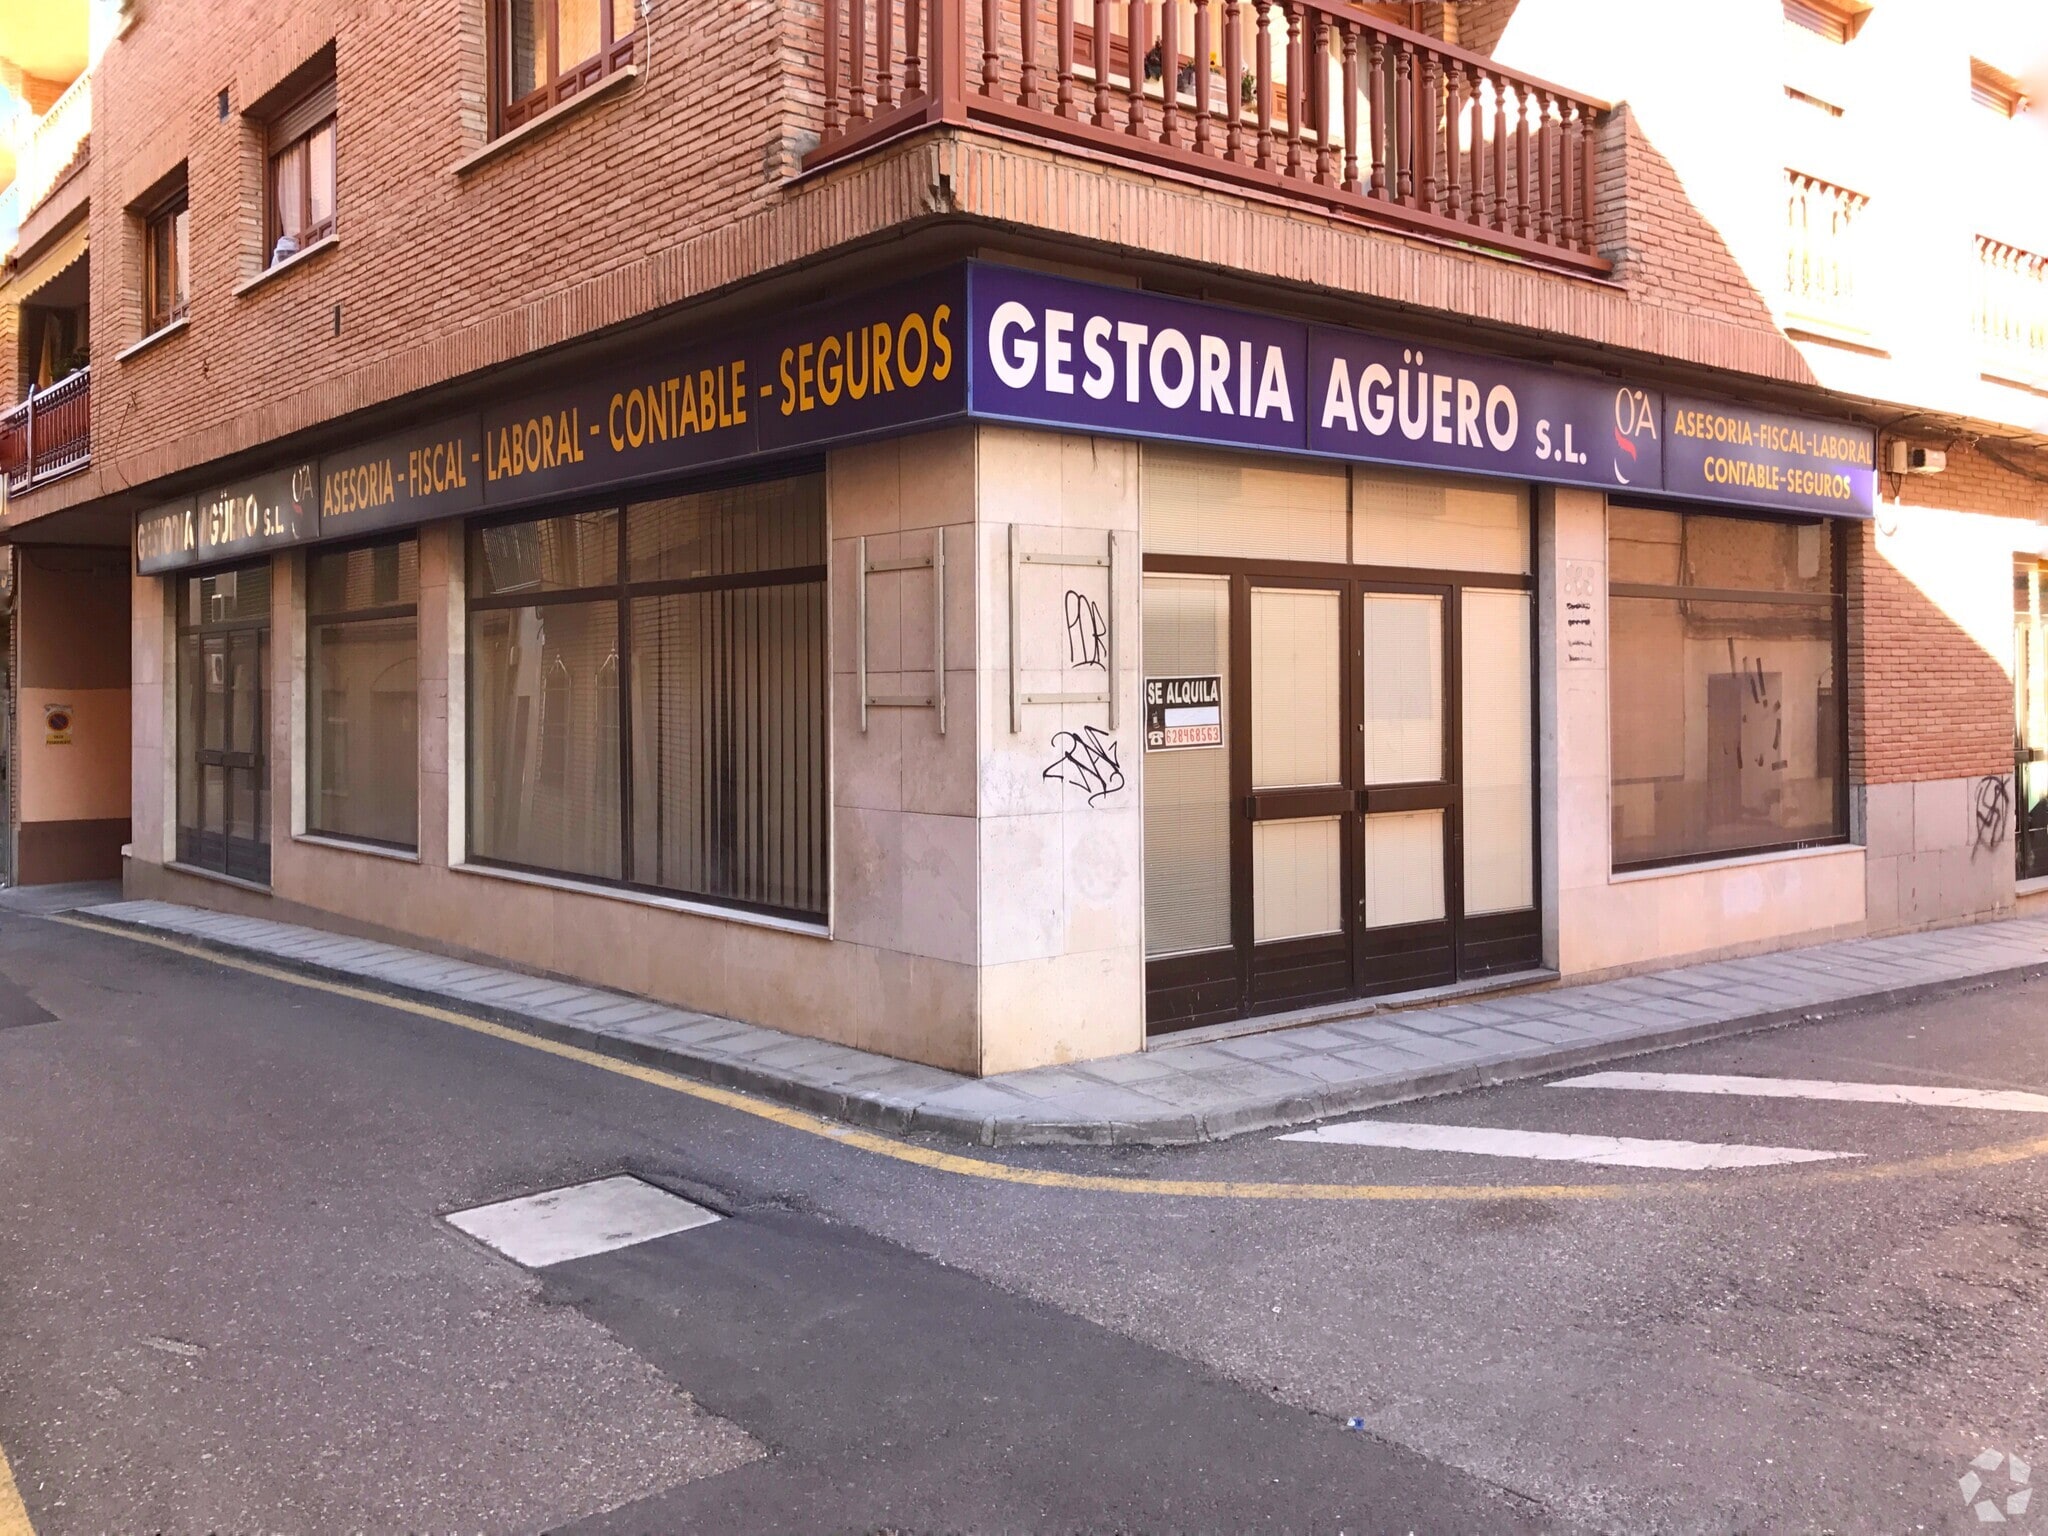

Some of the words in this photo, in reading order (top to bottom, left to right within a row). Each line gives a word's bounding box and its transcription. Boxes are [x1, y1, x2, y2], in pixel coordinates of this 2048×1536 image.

[323, 458, 395, 518] ASESORIA
[409, 438, 467, 498] FISCAL
[487, 406, 585, 482] LABORAL
[608, 359, 747, 453] CONTABLE
[779, 304, 953, 417] SEGUROS
[988, 301, 1295, 422] GESTORIA
[1321, 349, 1519, 452] AGÜERO
[1535, 419, 1588, 465] S.L.
[1147, 681, 1164, 705] SE
[1166, 679, 1219, 705] ALQUILA
[1166, 726, 1219, 744] 628468563
